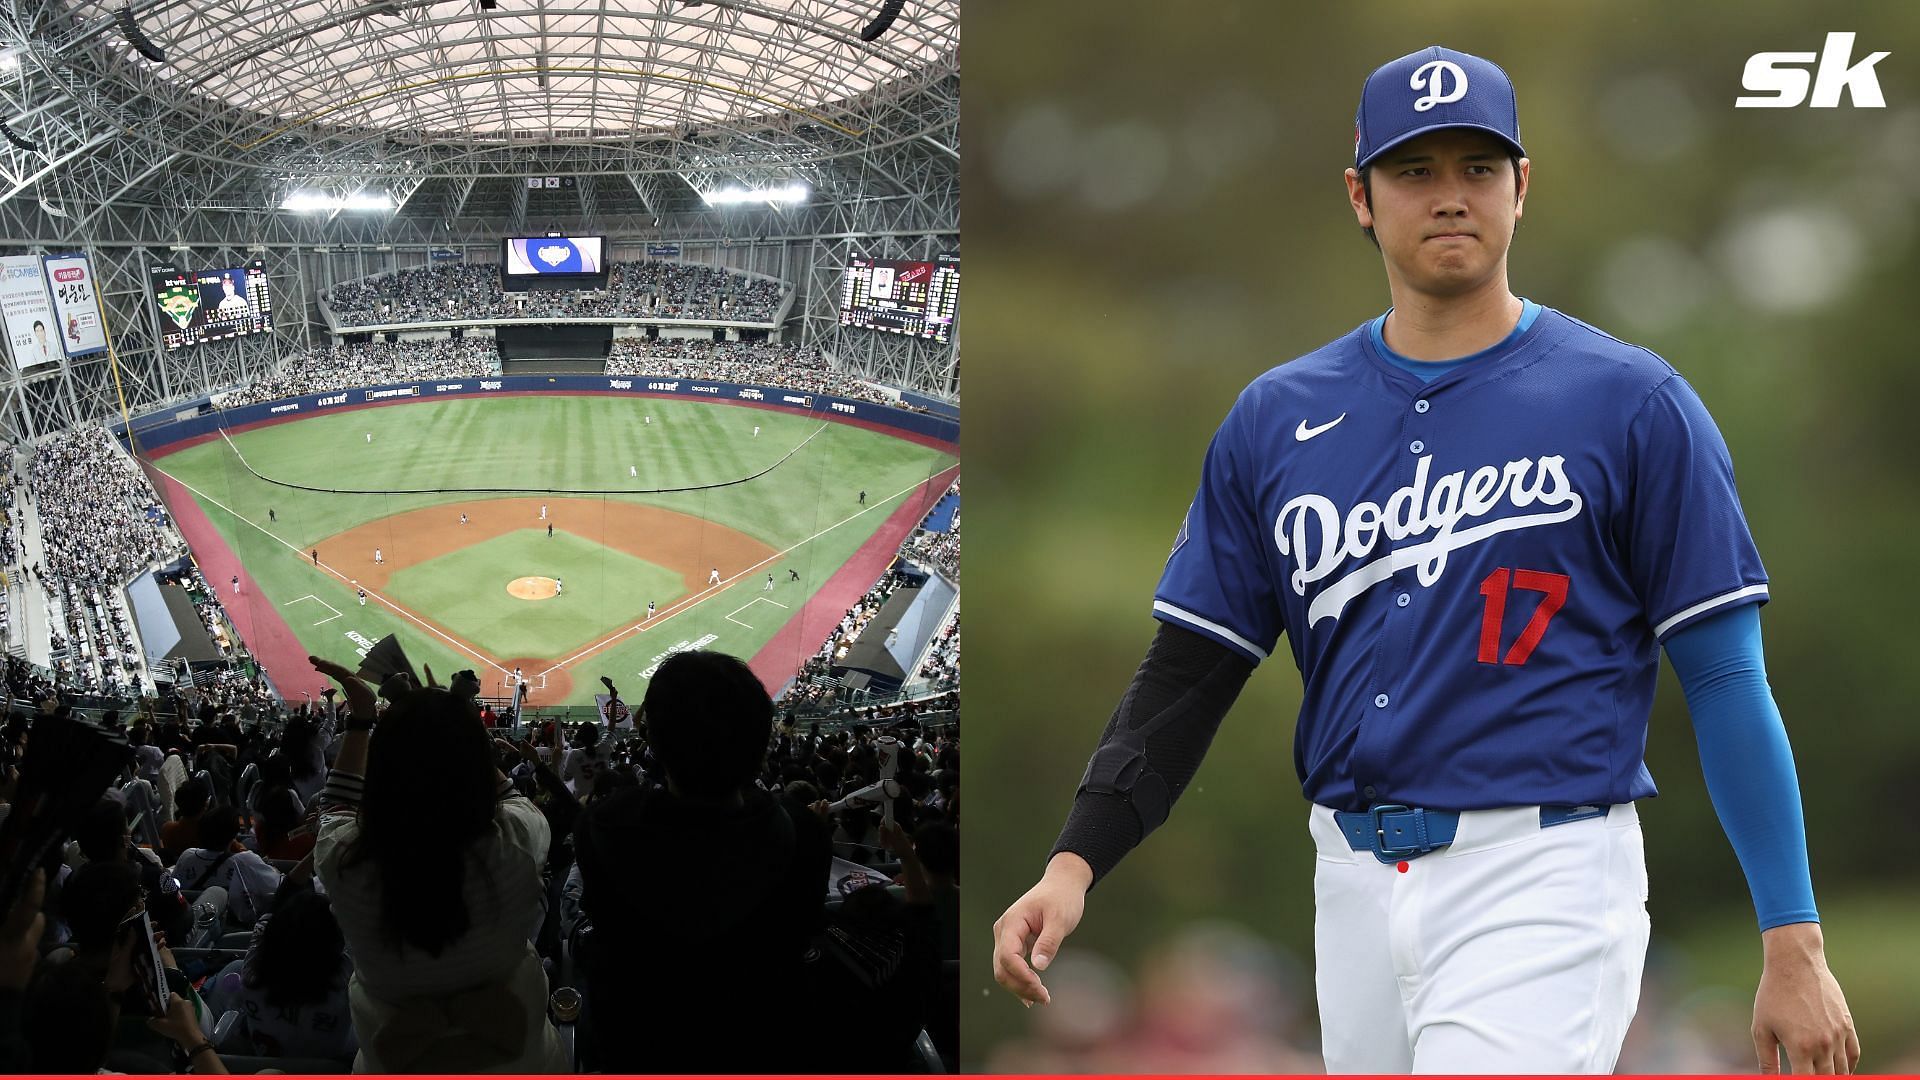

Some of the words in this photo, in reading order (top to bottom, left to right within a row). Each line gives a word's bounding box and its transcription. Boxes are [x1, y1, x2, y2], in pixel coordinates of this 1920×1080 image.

[1410, 60, 1468, 112] D
[710, 386, 719, 394] KT
[1275, 454, 1583, 628] Dodgers
[1479, 568, 1570, 666] 17
